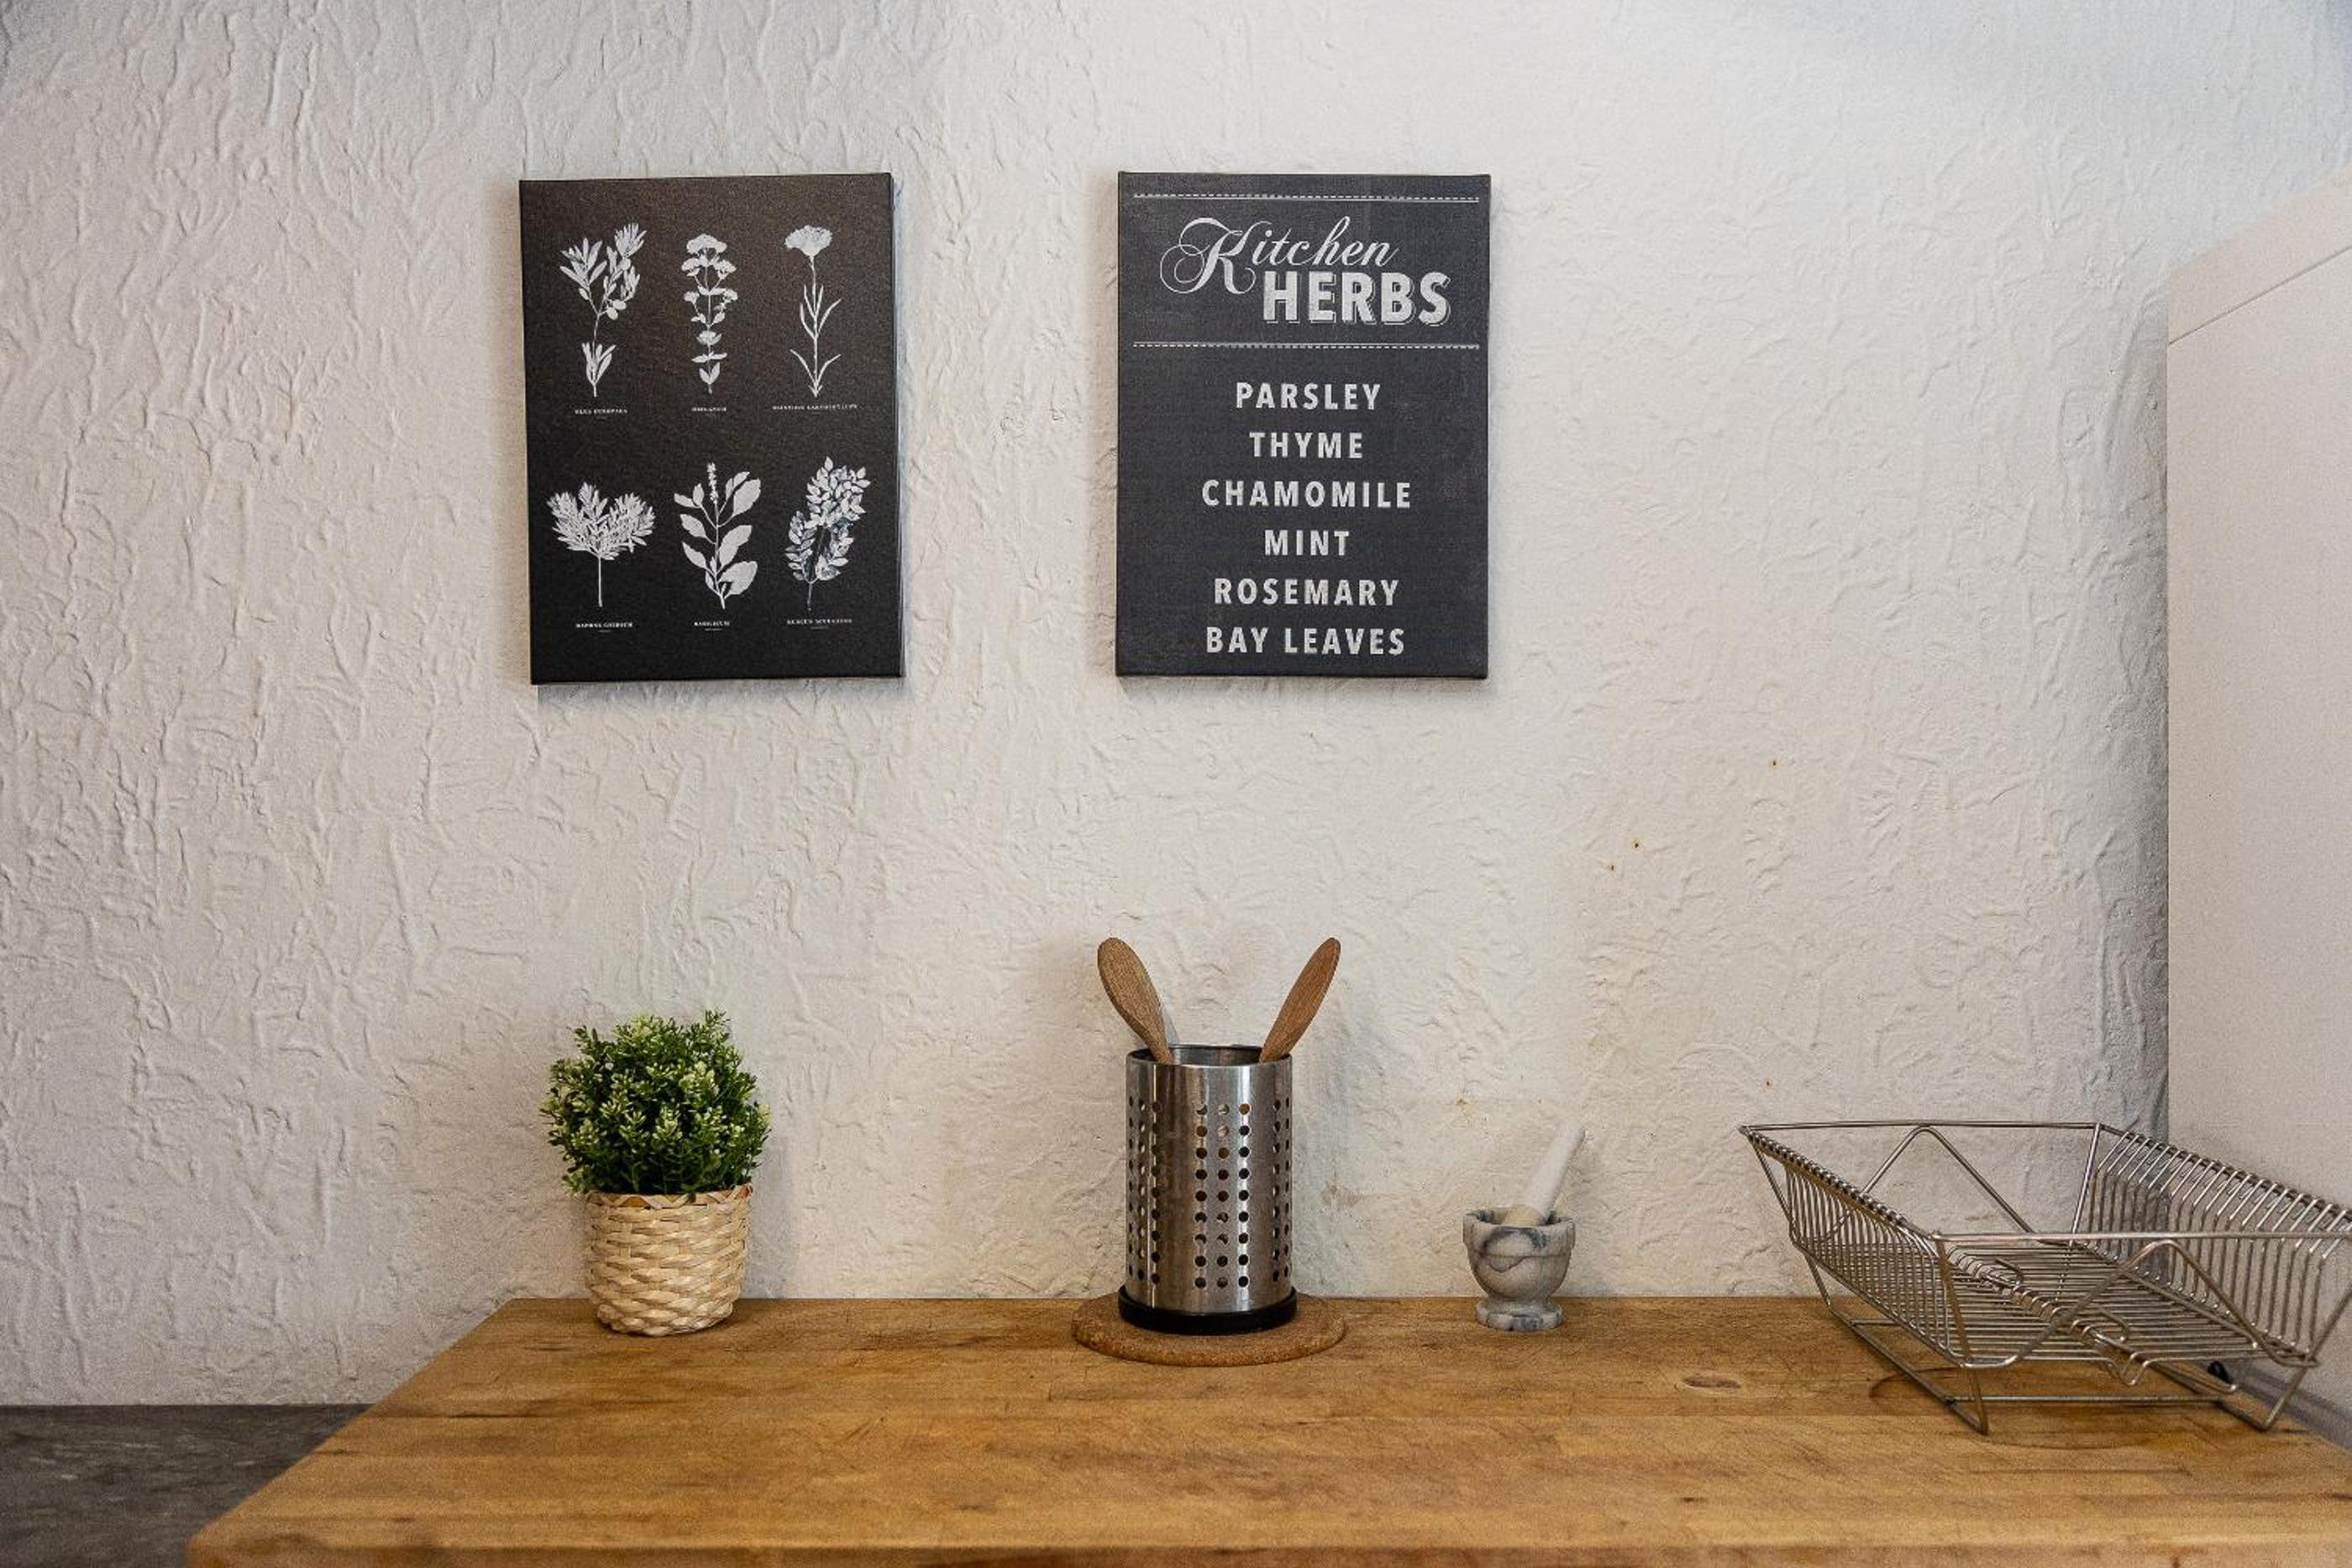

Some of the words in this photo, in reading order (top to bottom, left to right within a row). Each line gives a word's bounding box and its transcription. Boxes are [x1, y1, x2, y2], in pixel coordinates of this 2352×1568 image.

[1160, 216, 1401, 294] Kitchen
[1263, 270, 1452, 327] HERBS
[1236, 381, 1381, 411] PARSLEY
[1248, 432, 1362, 459] THYME
[1202, 479, 1410, 509] CHAMOMILE
[1264, 529, 1350, 556] MINT
[1214, 578, 1399, 606] ROSEMARY
[1206, 627, 1268, 653] BAY
[1284, 627, 1404, 656] LEAVES
